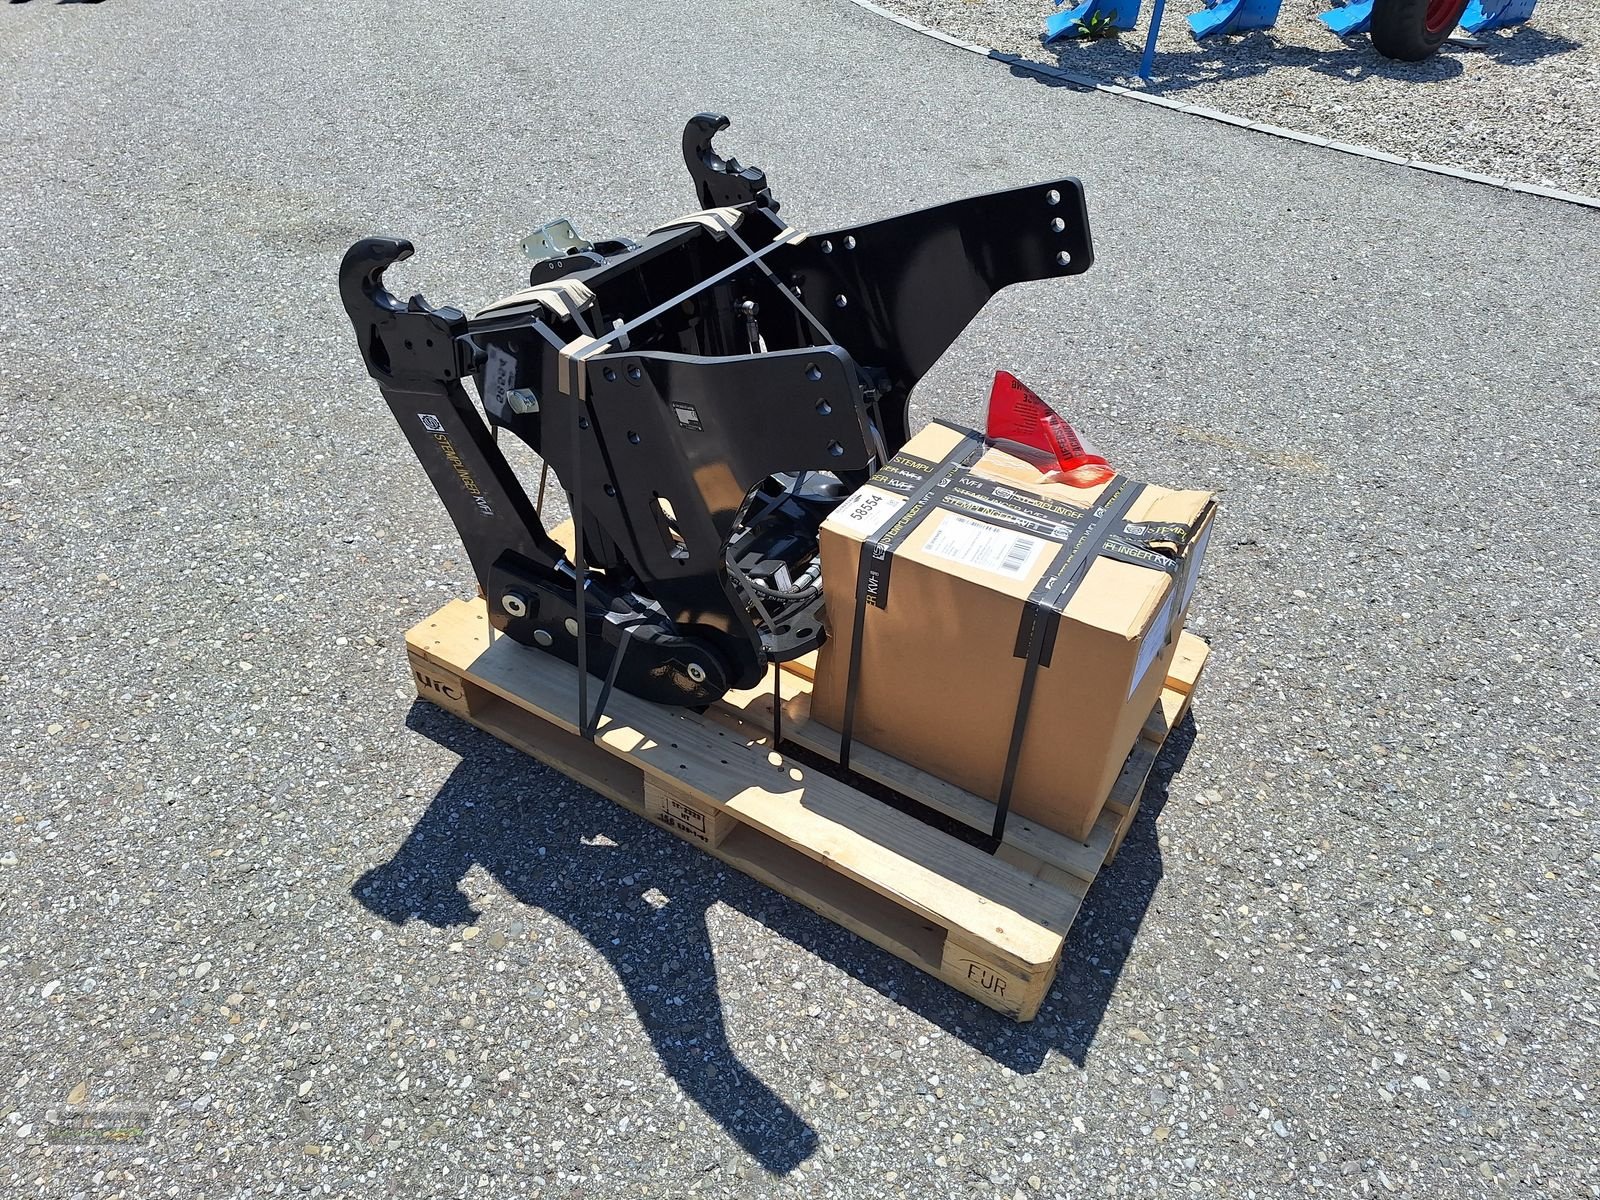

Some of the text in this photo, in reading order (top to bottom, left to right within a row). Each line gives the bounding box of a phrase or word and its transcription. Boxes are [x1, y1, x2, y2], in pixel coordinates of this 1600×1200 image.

[434, 433, 480, 495] STEMPLINGER
[850, 494, 882, 521] 58554
[967, 963, 1007, 997] EUR
